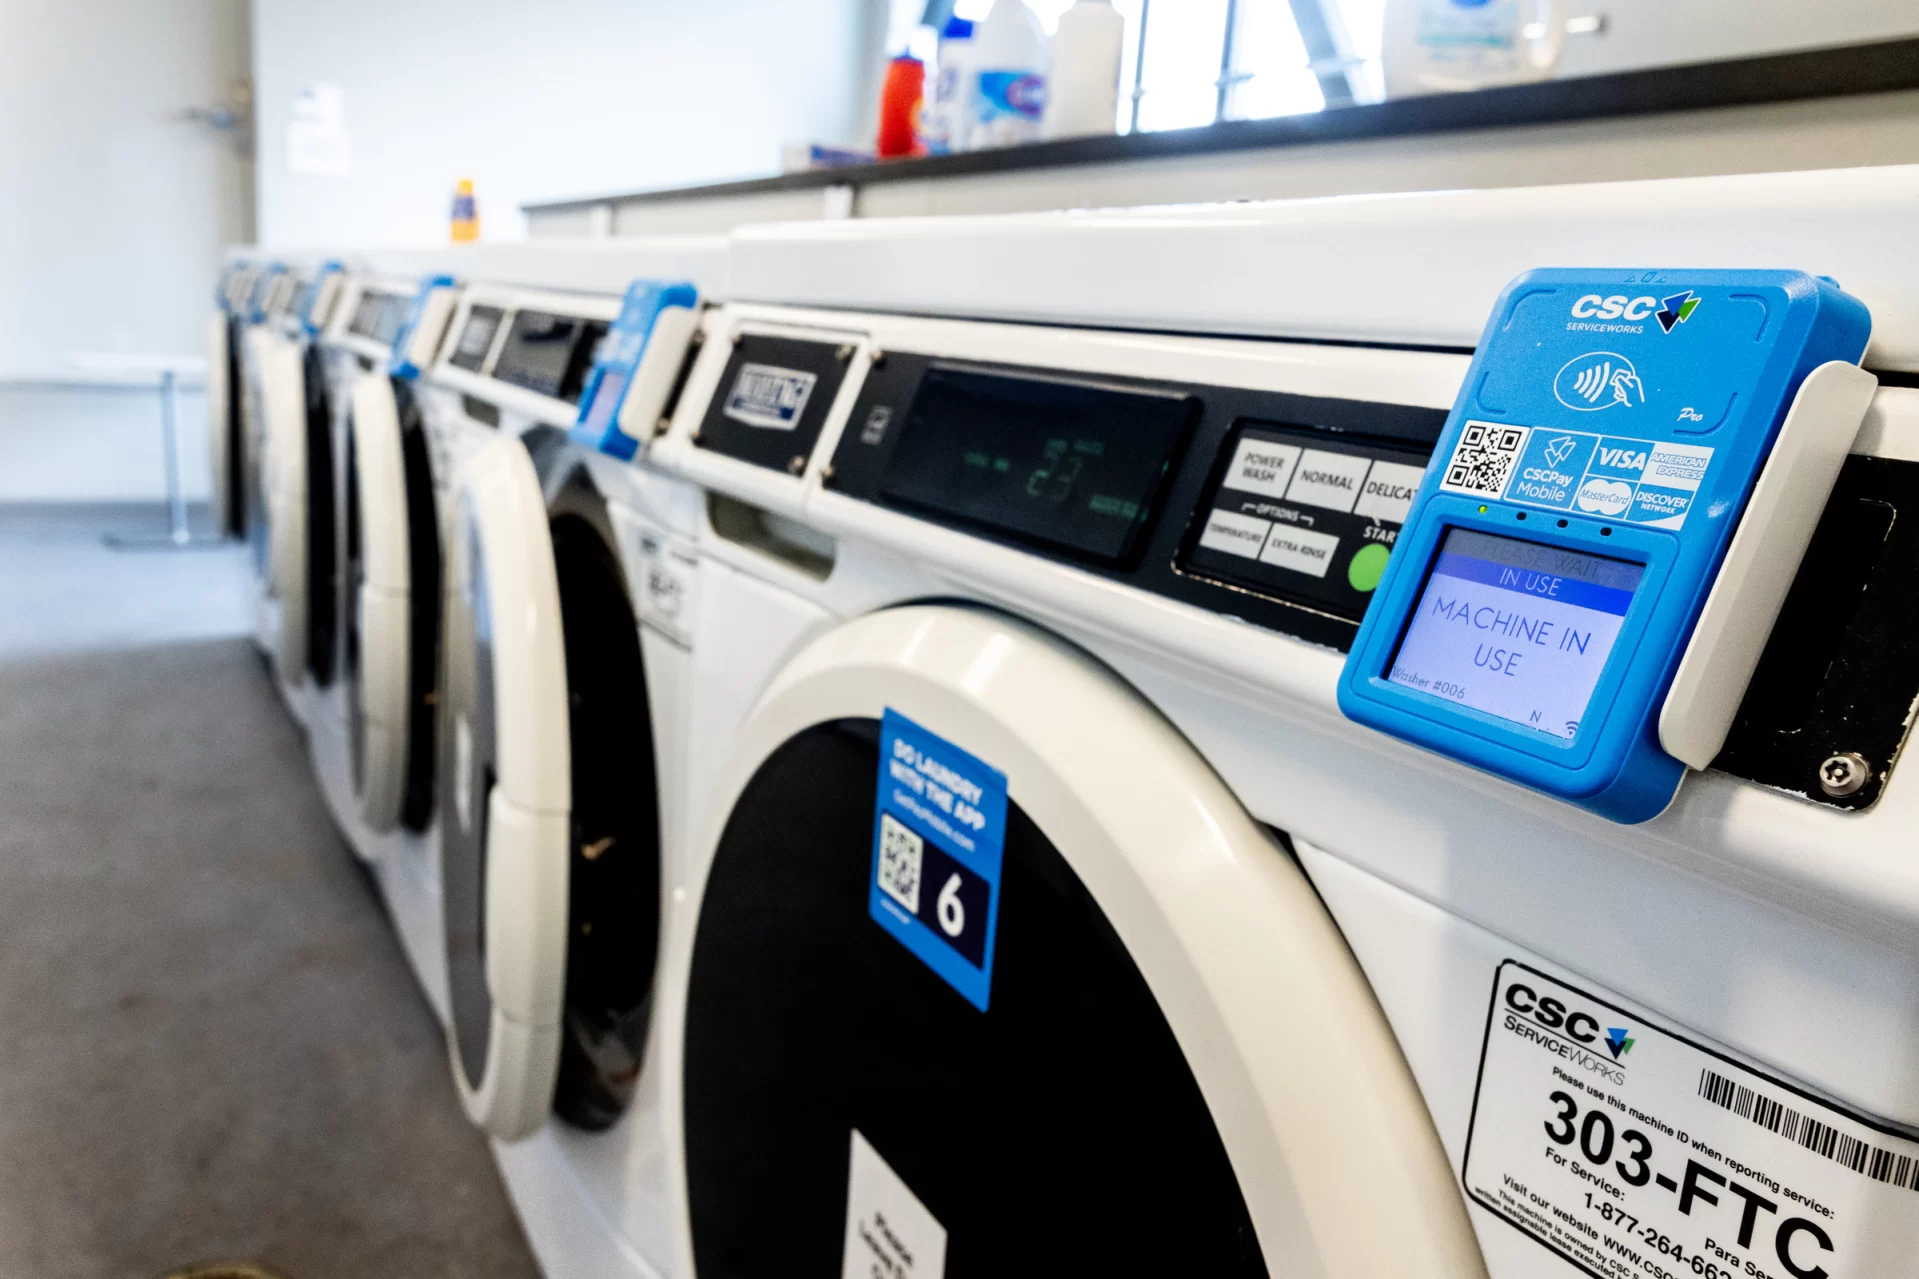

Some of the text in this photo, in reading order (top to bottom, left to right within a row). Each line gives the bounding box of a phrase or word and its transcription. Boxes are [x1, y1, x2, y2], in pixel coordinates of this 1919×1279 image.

[1571, 294, 1657, 321] CSC
[1566, 321, 1644, 334] SERVICEWORKS
[1677, 407, 1704, 422] Pro
[1244, 451, 1285, 470] POWER
[1599, 447, 1647, 471] VISA
[1650, 452, 1707, 468] AMERICAN
[1241, 466, 1275, 483] WASH
[1300, 469, 1354, 491] NORMAL
[1523, 467, 1573, 488] CSCPay
[1656, 465, 1704, 480] EXPRESS
[1516, 481, 1565, 501] Mobile
[1580, 488, 1631, 506] MasterCard
[1637, 491, 1689, 509] DISCOVER
[1255, 503, 1299, 522] OPTIONS
[1640, 503, 1676, 515] NETWORK
[1271, 537, 1298, 554] EXTRA
[1363, 525, 1399, 544] STAR
[1554, 553, 1605, 578] WAIT
[1500, 567, 1562, 597] IN USE
[1431, 596, 1592, 656] MACHINE IN
[1473, 643, 1523, 677] USE
[1392, 667, 1465, 700] Washer #006
[937, 872, 965, 938] 6
[1505, 983, 1600, 1043] CSC
[1552, 1066, 1836, 1220] Please use this machine ID when reporting service:
[1543, 1090, 1836, 1279] 303-FTC
[1545, 1146, 1627, 1202] For Service:
[1503, 1173, 1528, 1198] Visit
[1530, 1191, 1551, 1210] our
[1552, 1204, 1599, 1240] website
[1475, 1187, 1615, 1279] written assignable lease executed
[1499, 1189, 1631, 1277] This machine is owned by CSC
[1704, 1237, 1741, 1268] Para
